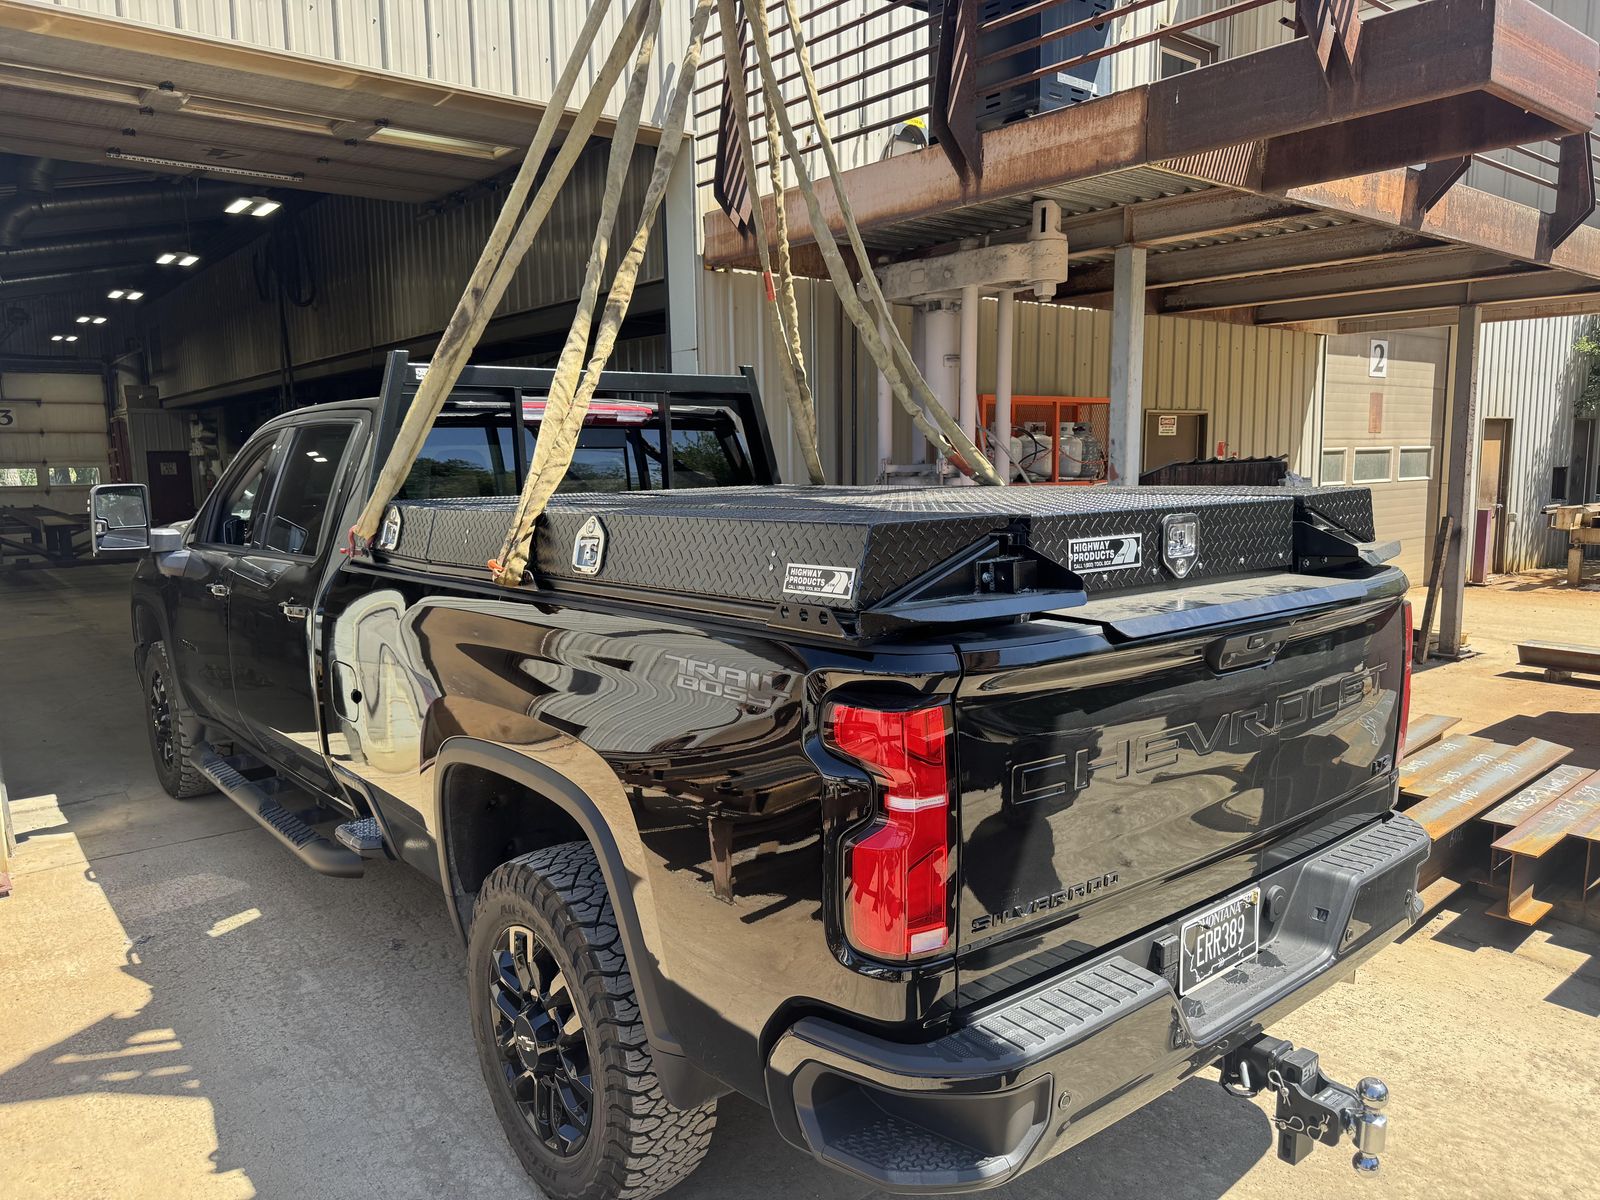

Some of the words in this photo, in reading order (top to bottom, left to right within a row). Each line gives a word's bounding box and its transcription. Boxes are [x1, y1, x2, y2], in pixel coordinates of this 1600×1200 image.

[1373, 344, 1384, 372] 2
[1073, 541, 1110, 552] HIGHWAY
[1073, 550, 1115, 562] PRODUCTS
[789, 576, 825, 586] PRODUCTS
[790, 567, 822, 577] HIGHWAY
[664, 654, 791, 699] TRAIL
[677, 674, 772, 708] BOSS
[1011, 662, 1387, 805] CHEVROLET
[971, 871, 1119, 933] SILVERADO
[1200, 902, 1242, 928] MONTANA
[1196, 914, 1245, 967] ERR389
